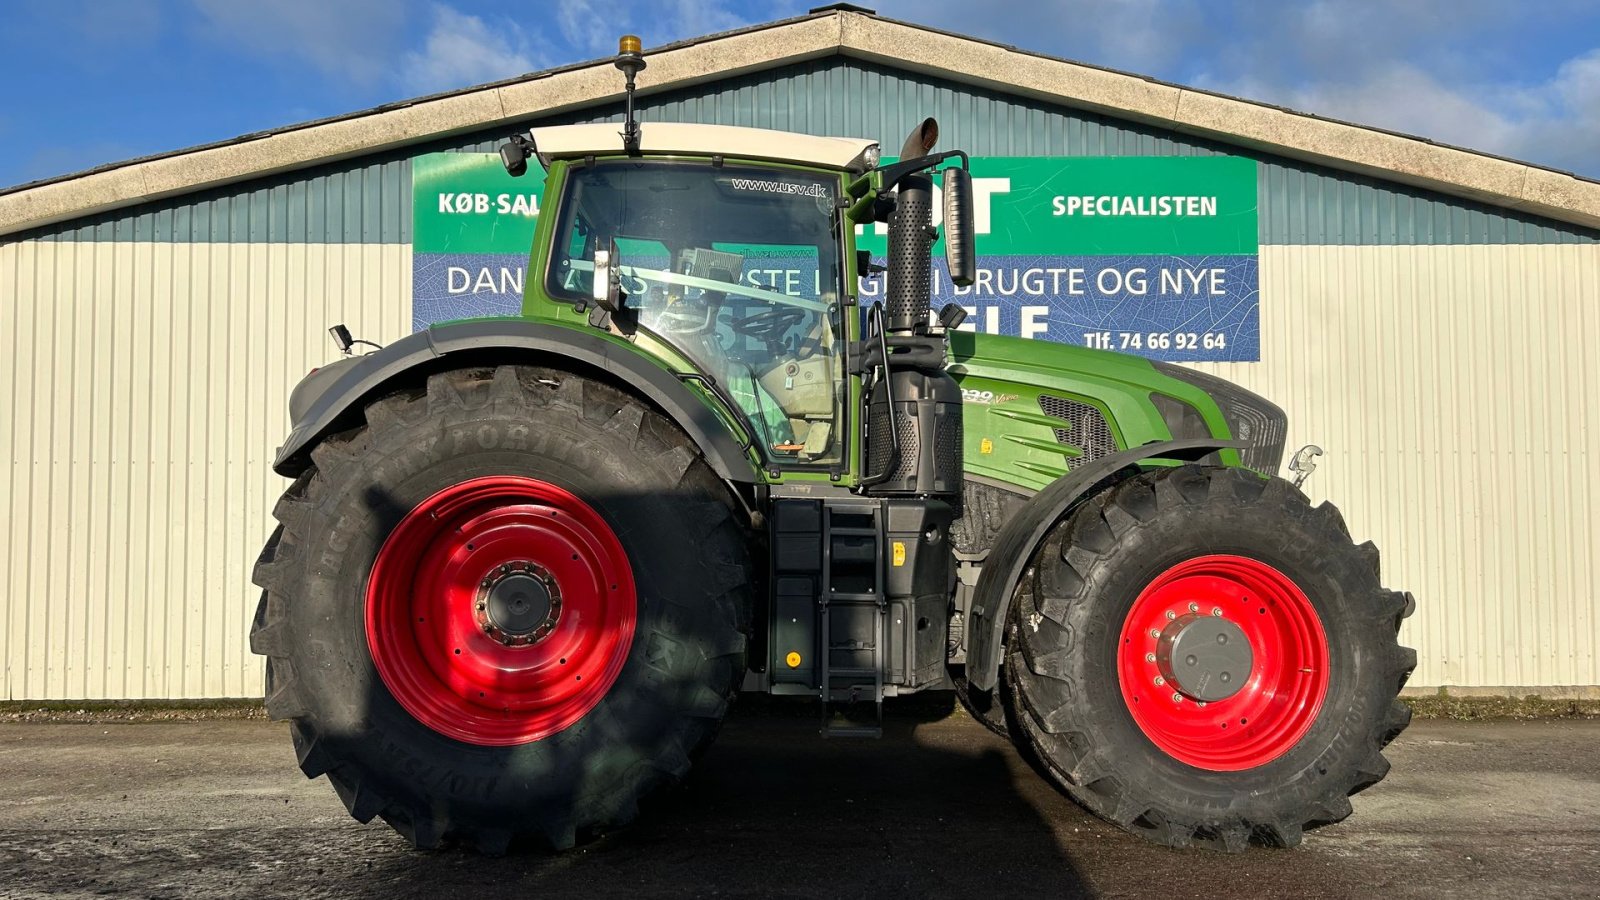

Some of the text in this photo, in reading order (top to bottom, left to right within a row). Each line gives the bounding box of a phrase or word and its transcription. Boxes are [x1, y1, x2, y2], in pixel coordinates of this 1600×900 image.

[732, 178, 826, 198] www.usv.dk
[438, 192, 541, 216] KØB·SAL
[1052, 195, 1218, 217] SPECIALISTEN
[1096, 267, 1148, 296] OG
[1161, 268, 1226, 296] NYE
[1084, 332, 1226, 350] Tlf. 74 66 92 64
